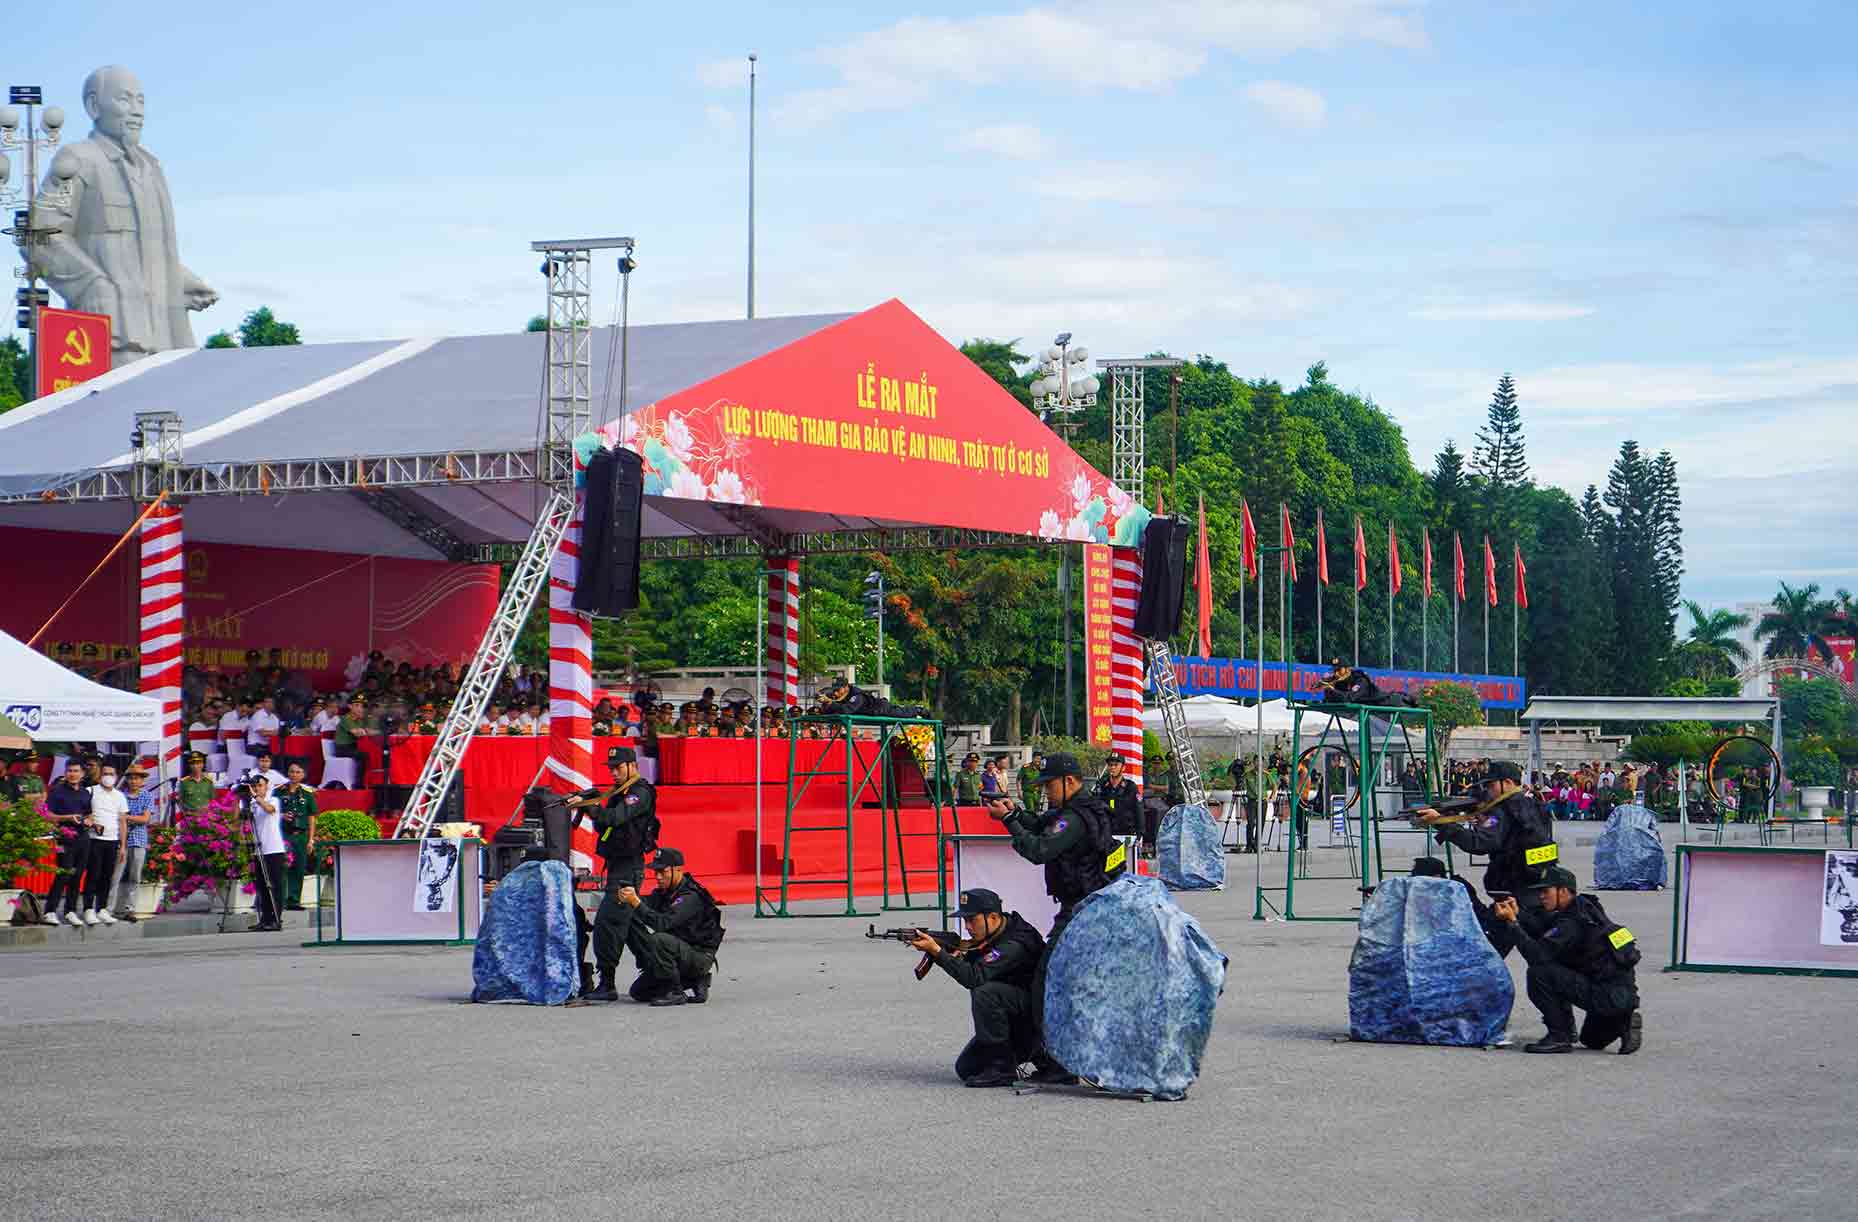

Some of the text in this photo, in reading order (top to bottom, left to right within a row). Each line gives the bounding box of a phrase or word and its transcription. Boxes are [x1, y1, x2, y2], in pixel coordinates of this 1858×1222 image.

[857, 360, 937, 419] LỄ RA MẮT
[723, 405, 751, 440] LỰC
[754, 409, 798, 447] LƯỢNG
[801, 417, 837, 447] THAM
[840, 422, 861, 450] GIA
[864, 417, 889, 454] BẢO
[891, 425, 906, 463] VỆ
[909, 432, 926, 459] AN
[963, 438, 989, 474] TRẬT
[991, 445, 1006, 477] TỰ
[1007, 440, 1016, 472] Ở
[1018, 449, 1034, 476] CƠ
[1035, 447, 1049, 479] SỞ
[1219, 659, 1235, 689] HỒ
